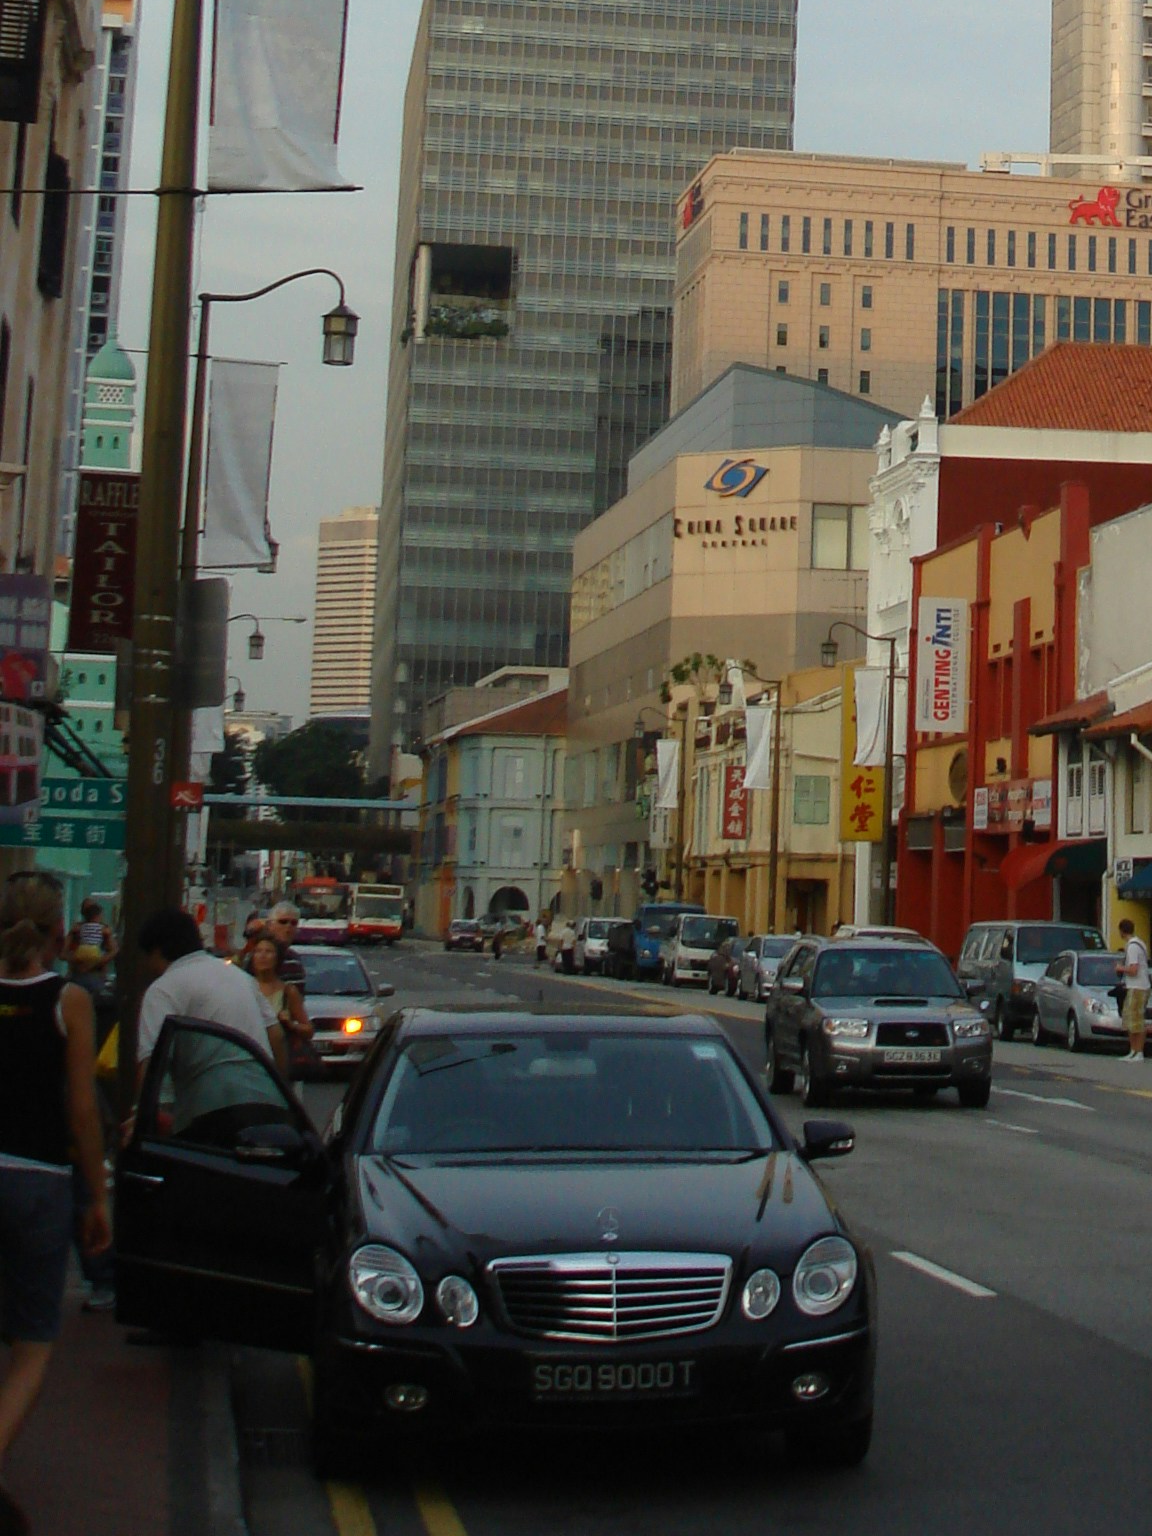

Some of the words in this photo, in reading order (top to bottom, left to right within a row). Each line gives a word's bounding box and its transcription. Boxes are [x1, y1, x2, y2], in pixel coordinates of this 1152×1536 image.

[89, 522, 129, 624] TAILOR
[933, 649, 952, 721] GENTING
[850, 767, 876, 833] 仁堂
